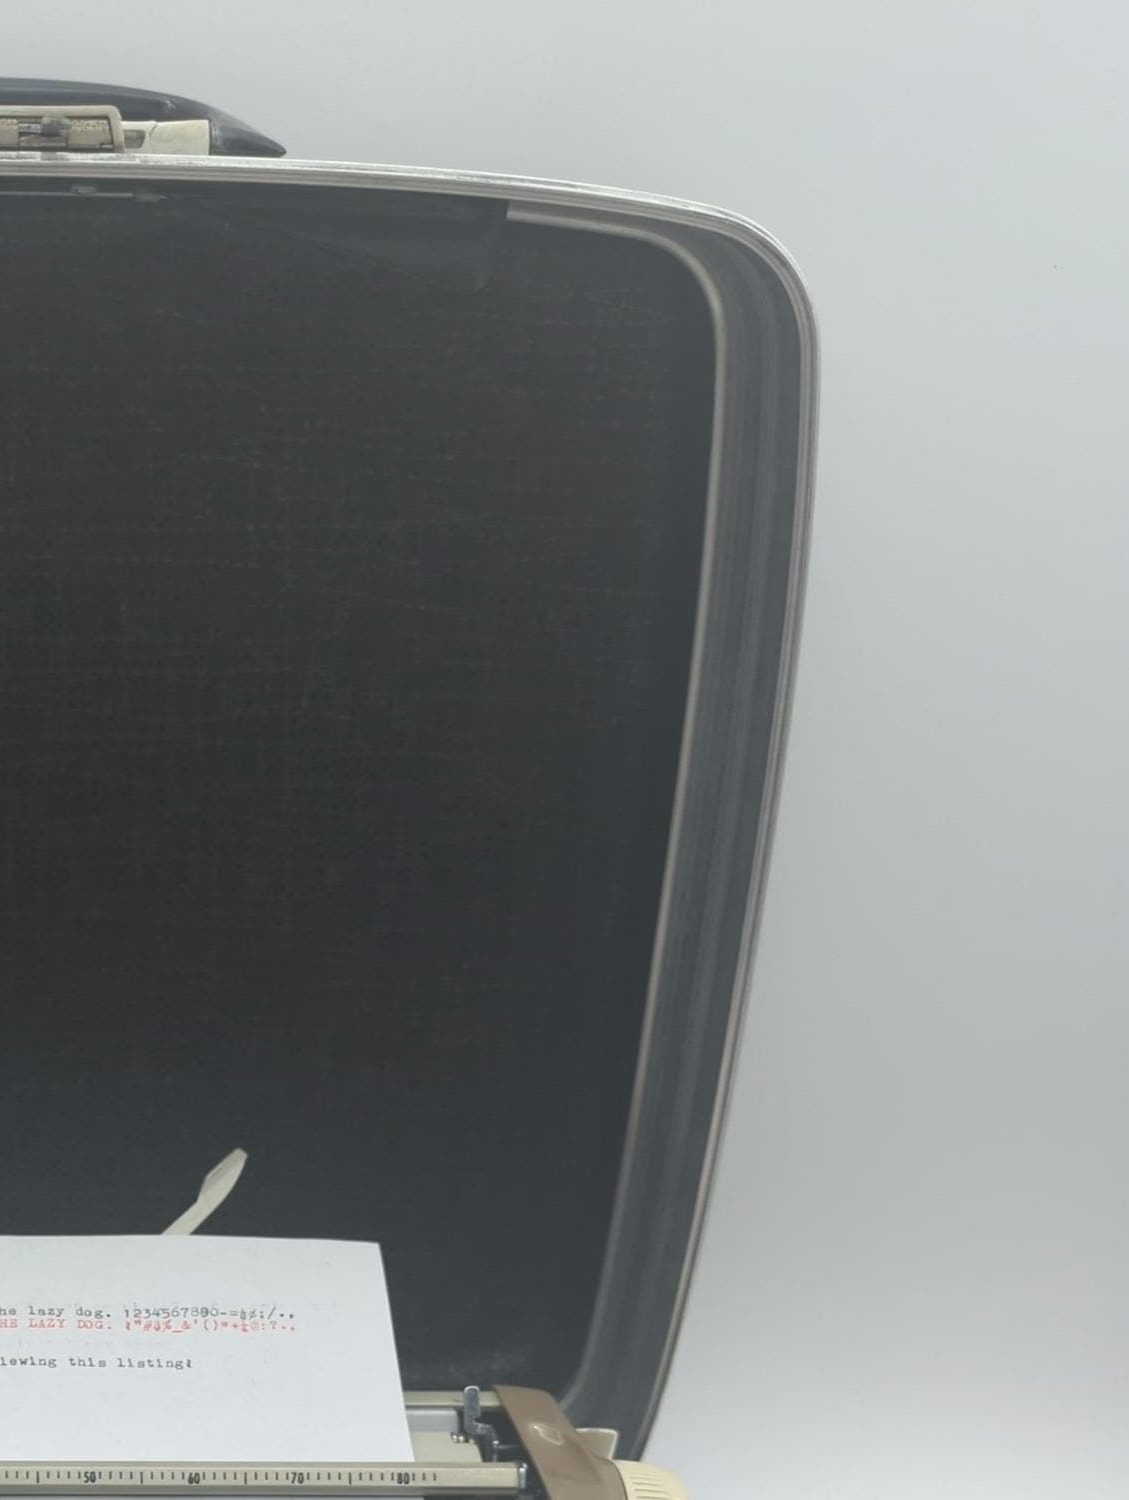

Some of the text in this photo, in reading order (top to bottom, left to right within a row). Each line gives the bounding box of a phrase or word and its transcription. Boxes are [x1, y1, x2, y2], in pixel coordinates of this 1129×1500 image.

[28, 1306, 64, 1318] lazy
[75, 1306, 111, 1319] dog.
[28, 1319, 66, 1329] LAZY
[77, 1319, 112, 1330] DOG.
[69, 1357, 107, 1368] this
[83, 1471, 97, 1484] 50
[187, 1471, 201, 1485] 60
[291, 1471, 304, 1485] 70
[397, 1472, 410, 1485] 80
